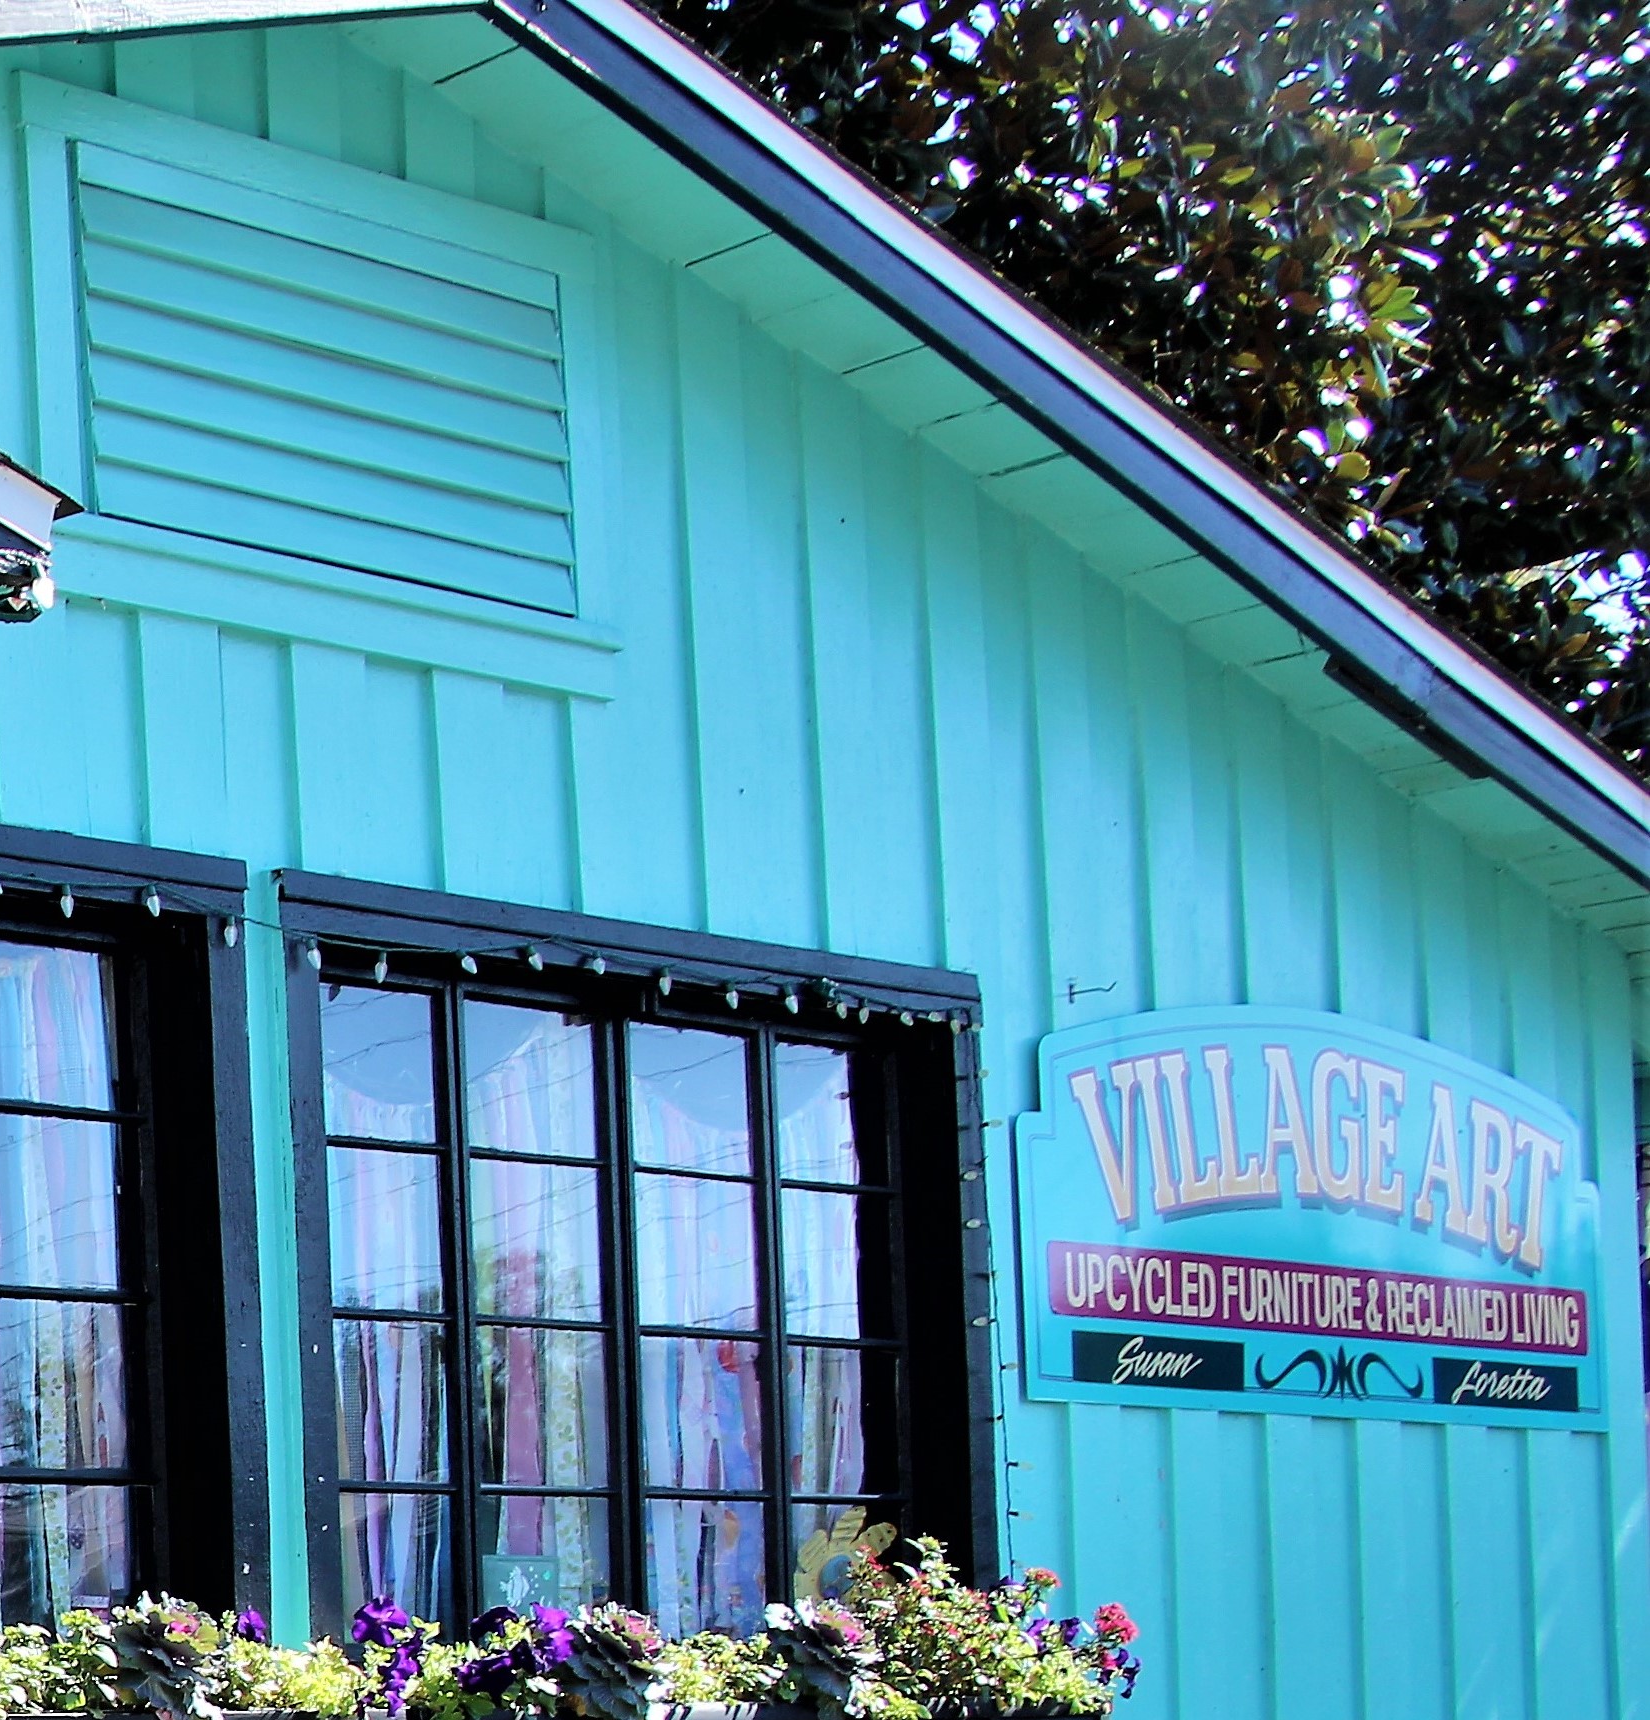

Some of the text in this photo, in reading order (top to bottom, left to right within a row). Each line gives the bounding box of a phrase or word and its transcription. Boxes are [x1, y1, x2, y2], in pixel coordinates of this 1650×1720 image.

[1068, 1044, 1565, 1274] VILLAGE ART
[1066, 1251, 1580, 1348] UPCYCLED FURNITURE & RECLAIMED LIVING
[1112, 1337, 1203, 1384] Susan
[1452, 1361, 1552, 1404] Loretta
